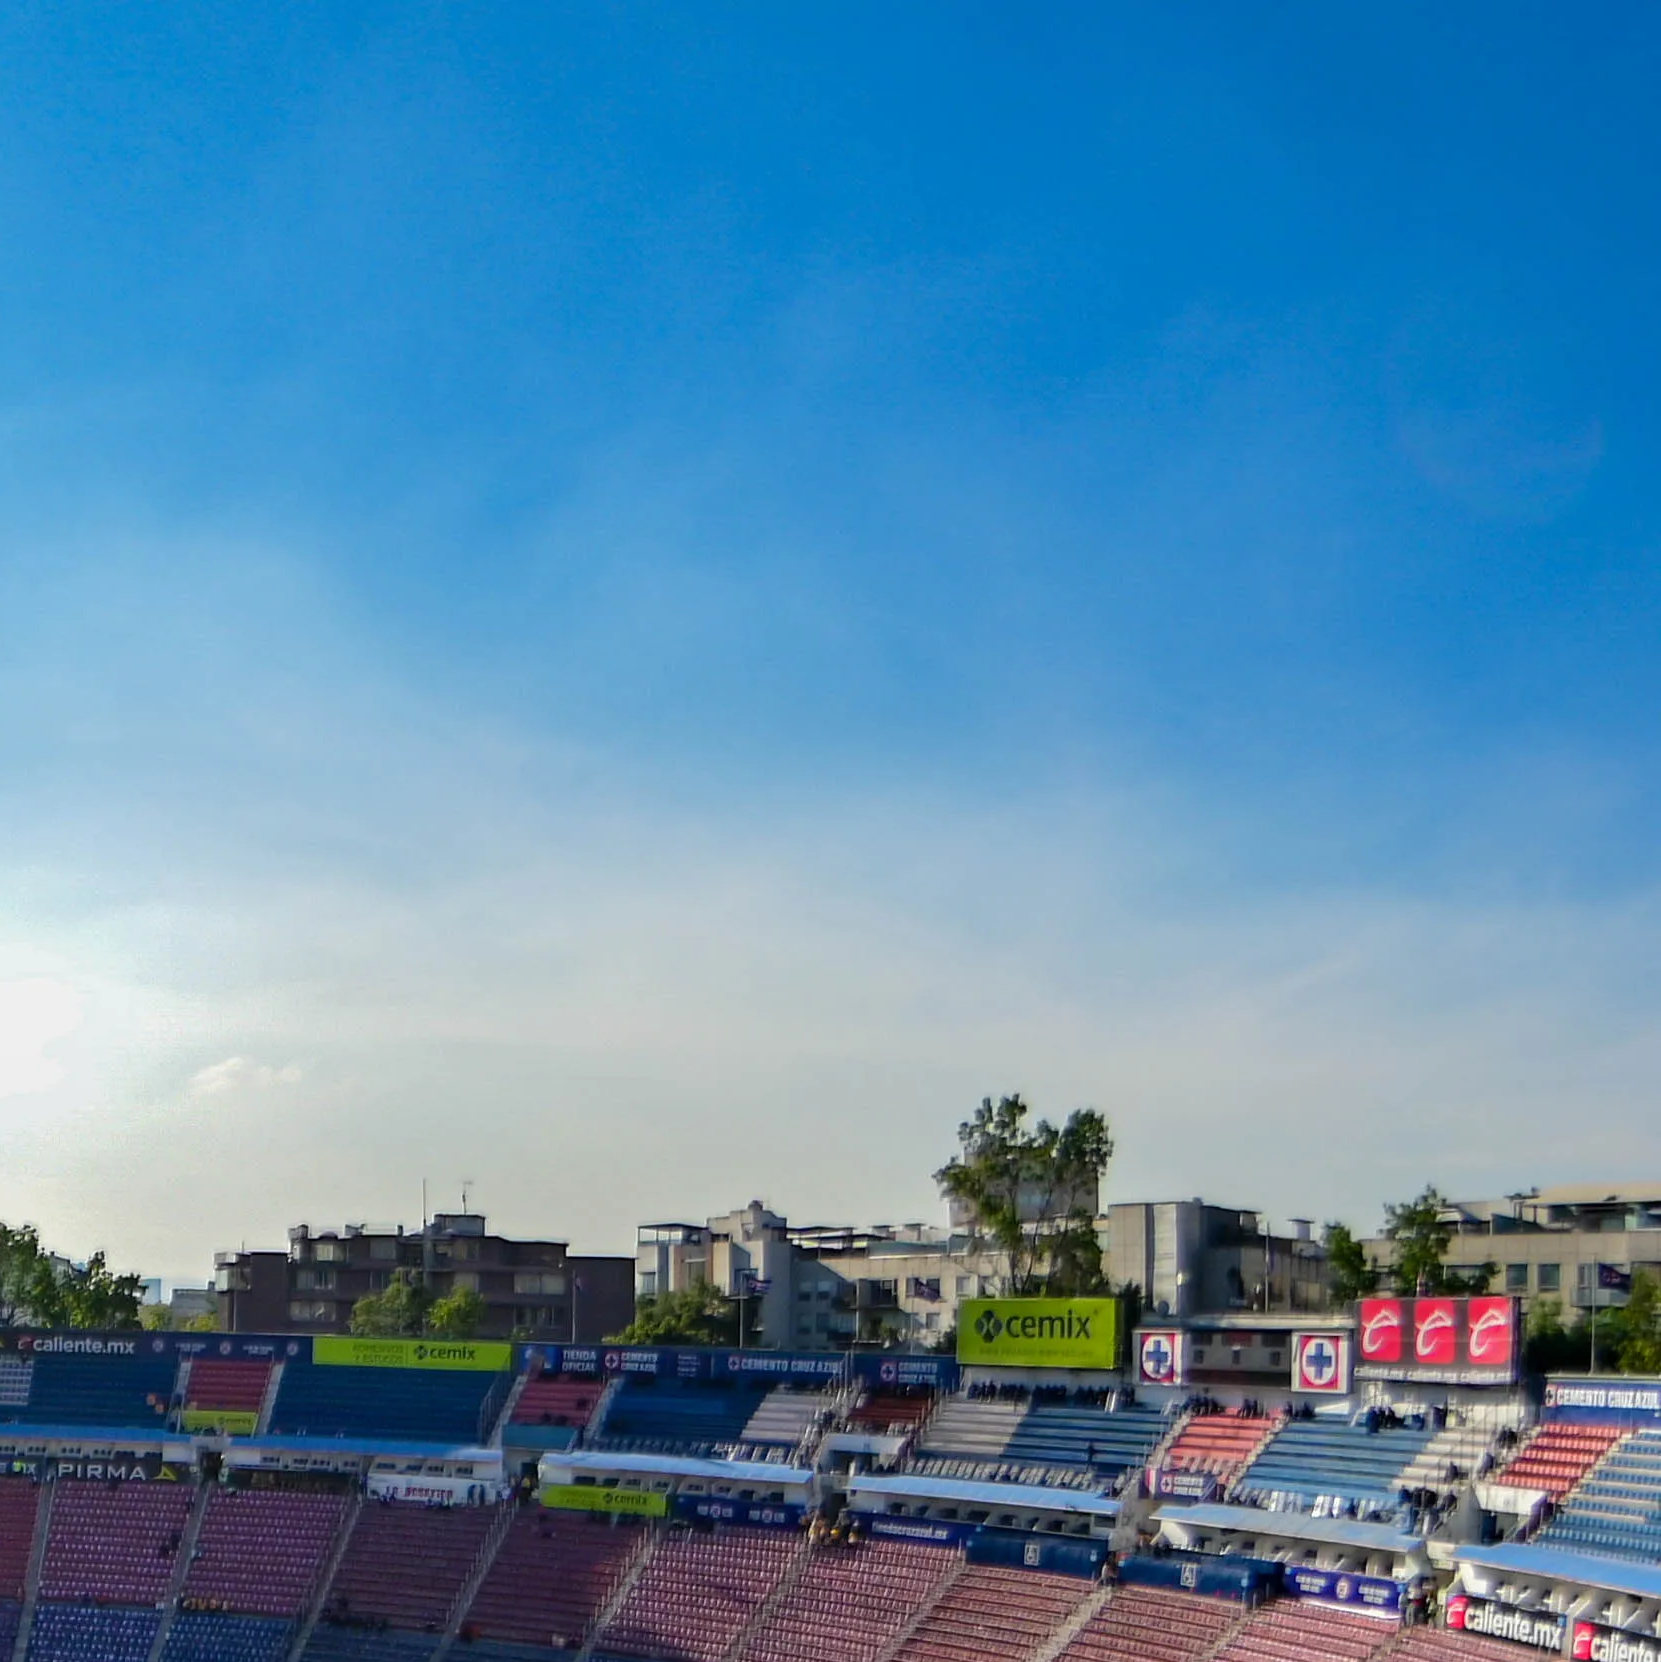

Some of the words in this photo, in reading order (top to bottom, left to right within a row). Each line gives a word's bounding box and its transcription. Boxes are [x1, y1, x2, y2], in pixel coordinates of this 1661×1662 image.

[1005, 1310, 1091, 1339] cemix
[33, 1335, 136, 1354] caliente.mx
[430, 1346, 475, 1361] cemix
[1556, 1387, 1605, 1404] CEMENTO
[1607, 1389, 1633, 1407] CRUZ
[1635, 1390, 1660, 1408] AZUL
[58, 1463, 147, 1480] PIRMA
[1464, 1602, 1562, 1650] caliente.mx
